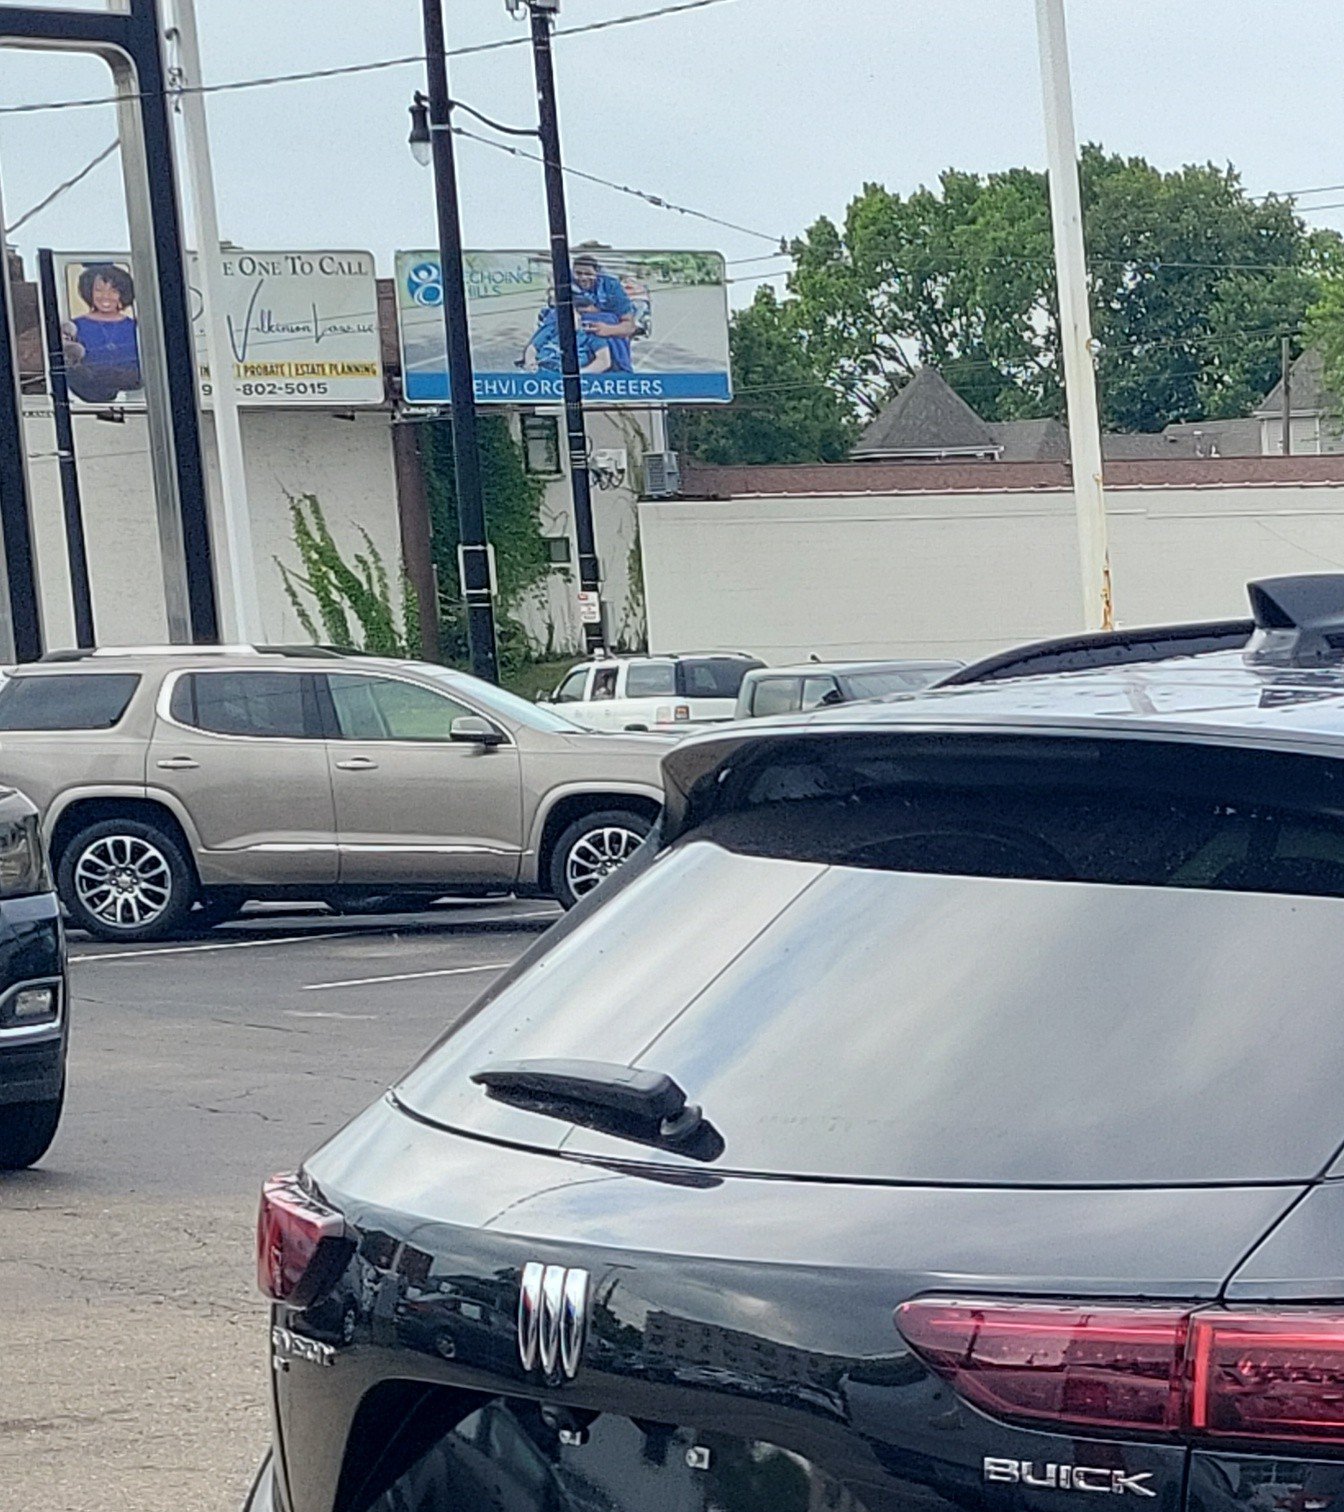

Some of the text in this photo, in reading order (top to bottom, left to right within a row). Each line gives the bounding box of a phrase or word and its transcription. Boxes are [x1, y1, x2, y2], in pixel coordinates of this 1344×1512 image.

[239, 256, 281, 276] ONE
[285, 256, 313, 276] TO
[319, 256, 368, 276] CALL
[466, 270, 533, 284] CHOING
[244, 363, 377, 376] PROBATE ESTATE PLANNING
[202, 383, 328, 396] 9-802-5015
[984, 1457, 1157, 1497] BUICK
